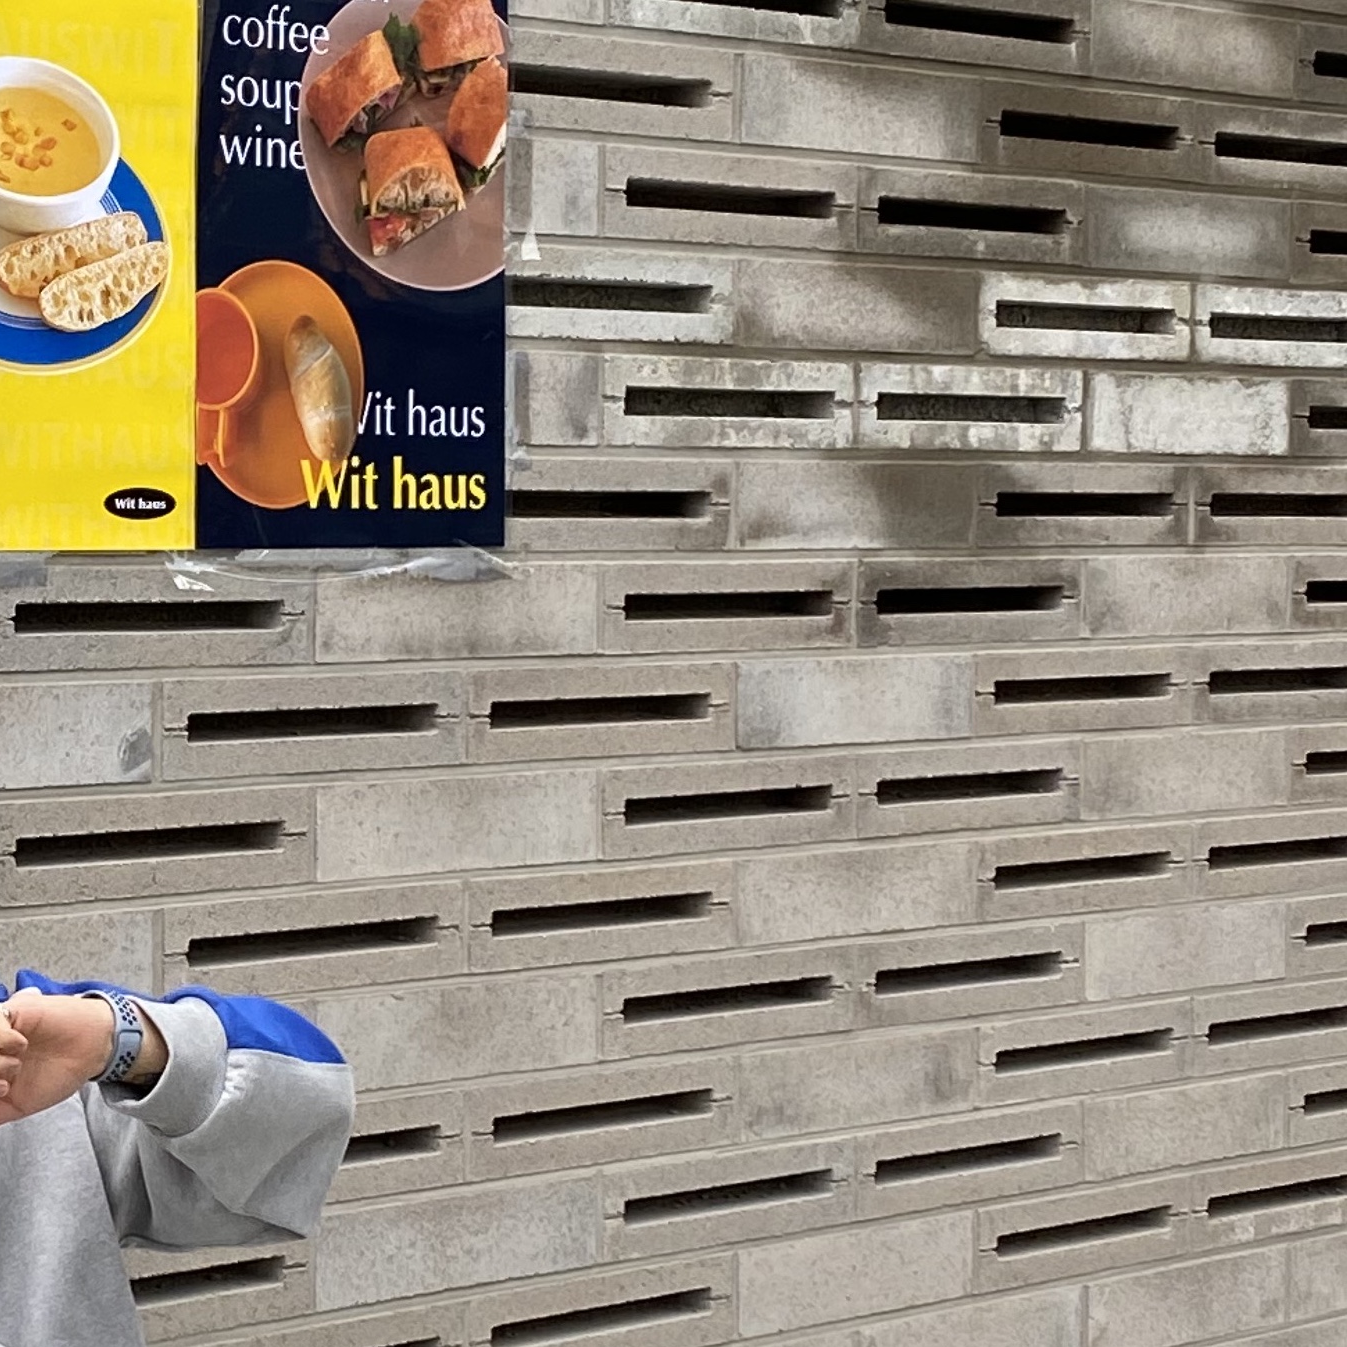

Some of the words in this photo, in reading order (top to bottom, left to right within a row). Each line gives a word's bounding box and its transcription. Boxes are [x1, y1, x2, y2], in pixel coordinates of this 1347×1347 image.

[222, 4, 330, 54] coffee
[220, 74, 302, 125] soup
[219, 126, 308, 171] wine
[408, 388, 486, 438] haus
[114, 496, 136, 510] Wit
[138, 496, 167, 510] haus
[300, 456, 379, 510] Wit
[393, 456, 487, 510] haus
